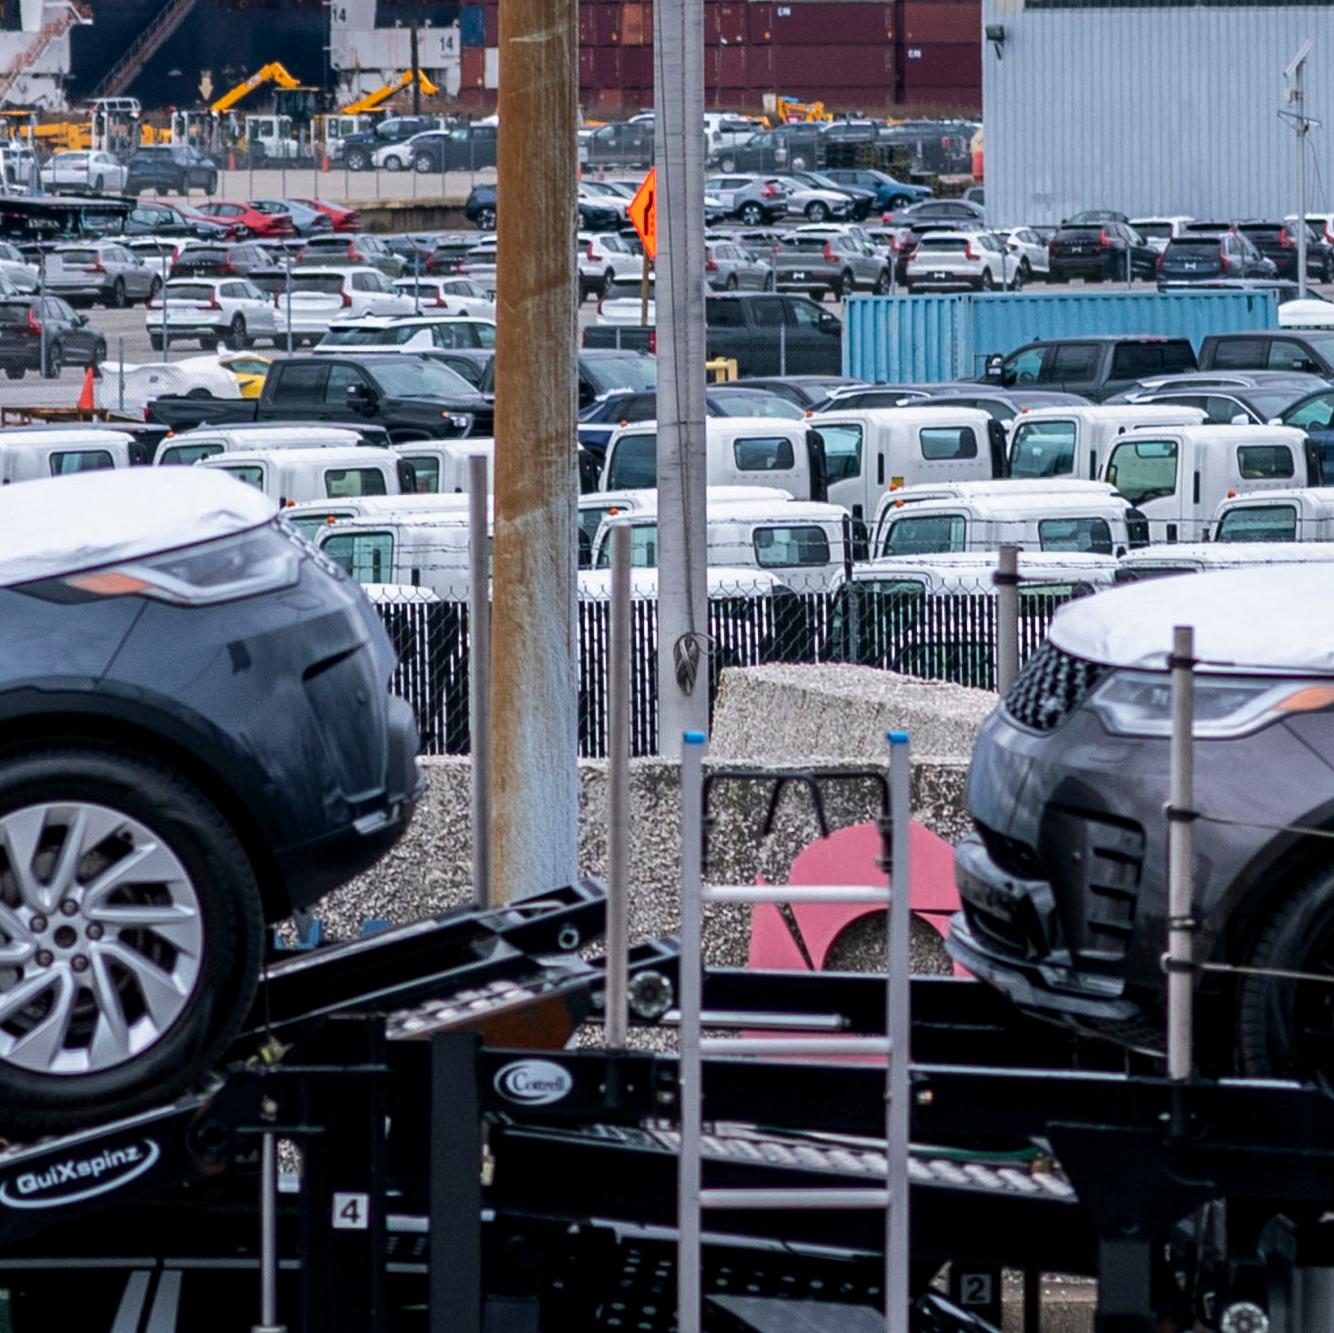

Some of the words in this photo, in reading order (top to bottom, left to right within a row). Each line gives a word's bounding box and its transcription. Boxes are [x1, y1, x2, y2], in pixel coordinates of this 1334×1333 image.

[333, 9, 346, 22] 14
[441, 36, 453, 50] 14
[340, 1198, 362, 1223] 4
[967, 1277, 986, 1302] 2
